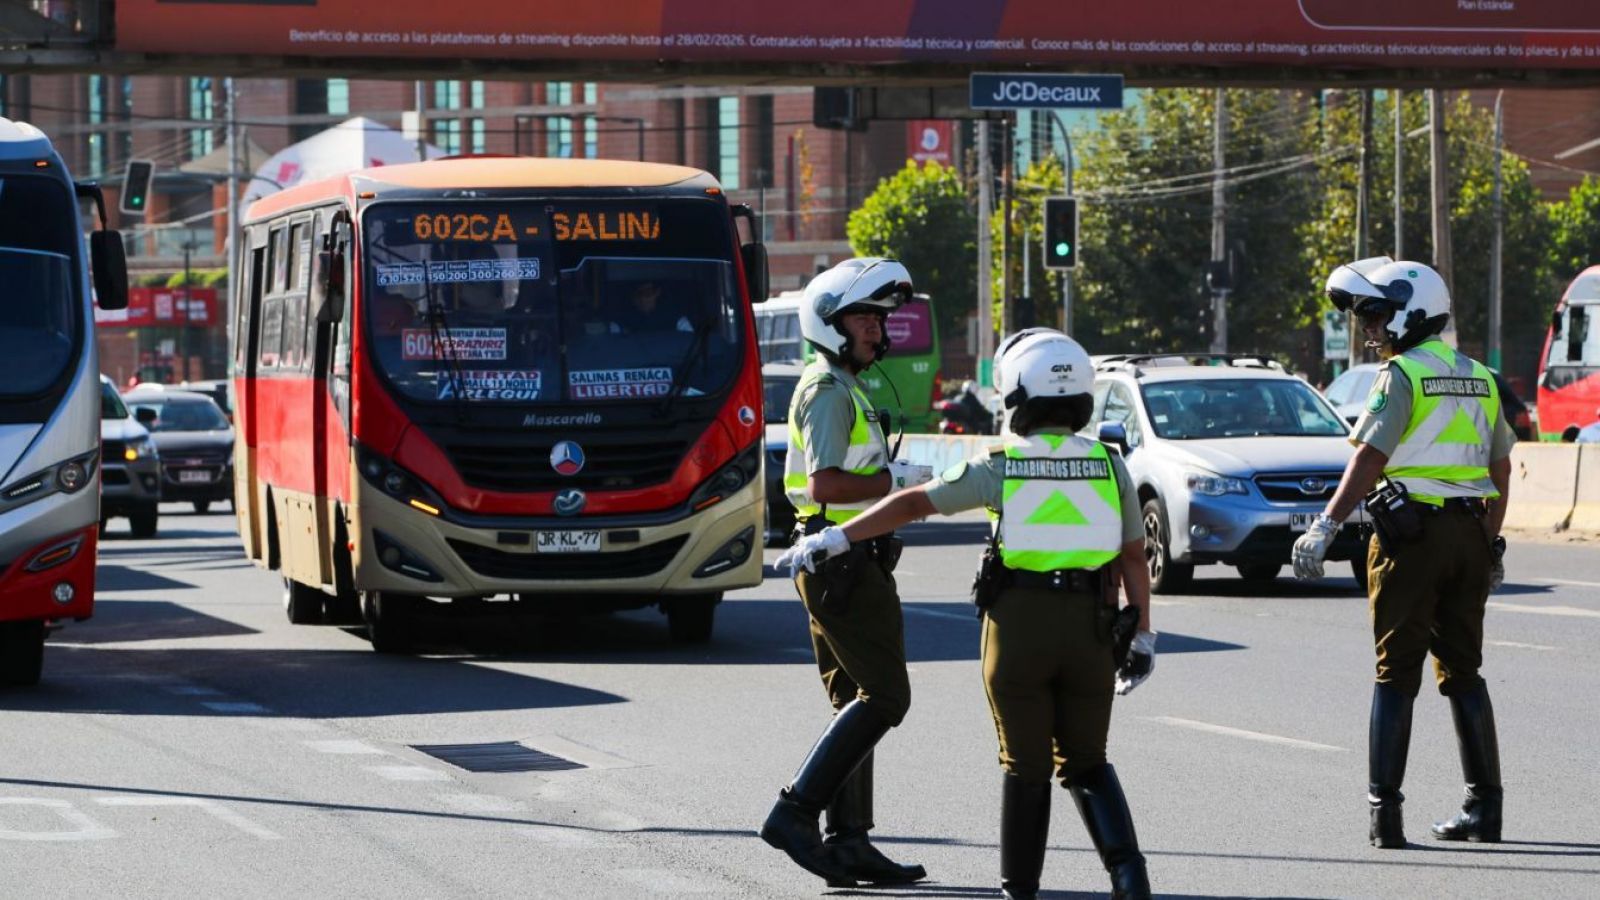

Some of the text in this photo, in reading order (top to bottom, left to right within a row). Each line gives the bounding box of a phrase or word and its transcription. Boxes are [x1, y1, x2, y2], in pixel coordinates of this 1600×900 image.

[289, 29, 343, 42] Beneficio
[345, 30, 360, 42] de
[362, 32, 399, 43] acceso
[402, 33, 409, 43] a
[412, 30, 428, 43] las
[430, 31, 496, 46] plataformas
[498, 32, 513, 44] de
[515, 33, 570, 47] streaming
[572, 33, 628, 47] disponible
[631, 33, 661, 46] hasta
[663, 33, 674, 46] el
[676, 34, 746, 47] 28/02/2026.
[749, 34, 817, 48] Contratación
[819, 35, 851, 49] sujeta
[854, 38, 862, 48] a
[863, 36, 924, 49] factibilidad
[925, 36, 964, 49] técnica
[965, 39, 973, 51] y
[974, 37, 1026, 50] comercial.
[1031, 38, 1070, 51] Conoce
[1072, 38, 1094, 51] más
[1096, 38, 1110, 51] de
[1112, 38, 1127, 51] las
[1129, 39, 1189, 52] condiciones
[1191, 40, 1206, 53] de
[1207, 42, 1243, 53] acceso
[1245, 41, 1255, 54] al
[1387, 43, 1491, 57] técnicas/comerciales
[1493, 44, 1508, 57] de
[1509, 44, 1524, 57] los
[1525, 44, 1559, 59] planes
[1561, 47, 1568, 59] y
[1569, 44, 1583, 58] de
[1584, 44, 1594, 58] la
[992, 81, 1102, 102] JCDecaux
[414, 213, 518, 241] 602CA
[448, 272, 468, 280] 200
[471, 271, 492, 279] 300
[494, 270, 515, 279] 260
[518, 269, 537, 278] 220
[1050, 364, 1073, 373] GIVI
[507, 379, 537, 389] NORTE
[571, 371, 619, 384] SALINAS
[575, 383, 670, 398] LIBERTAD
[522, 411, 602, 427] Mascarello
[1005, 459, 1108, 477] CARABINEROS DE CHILE
